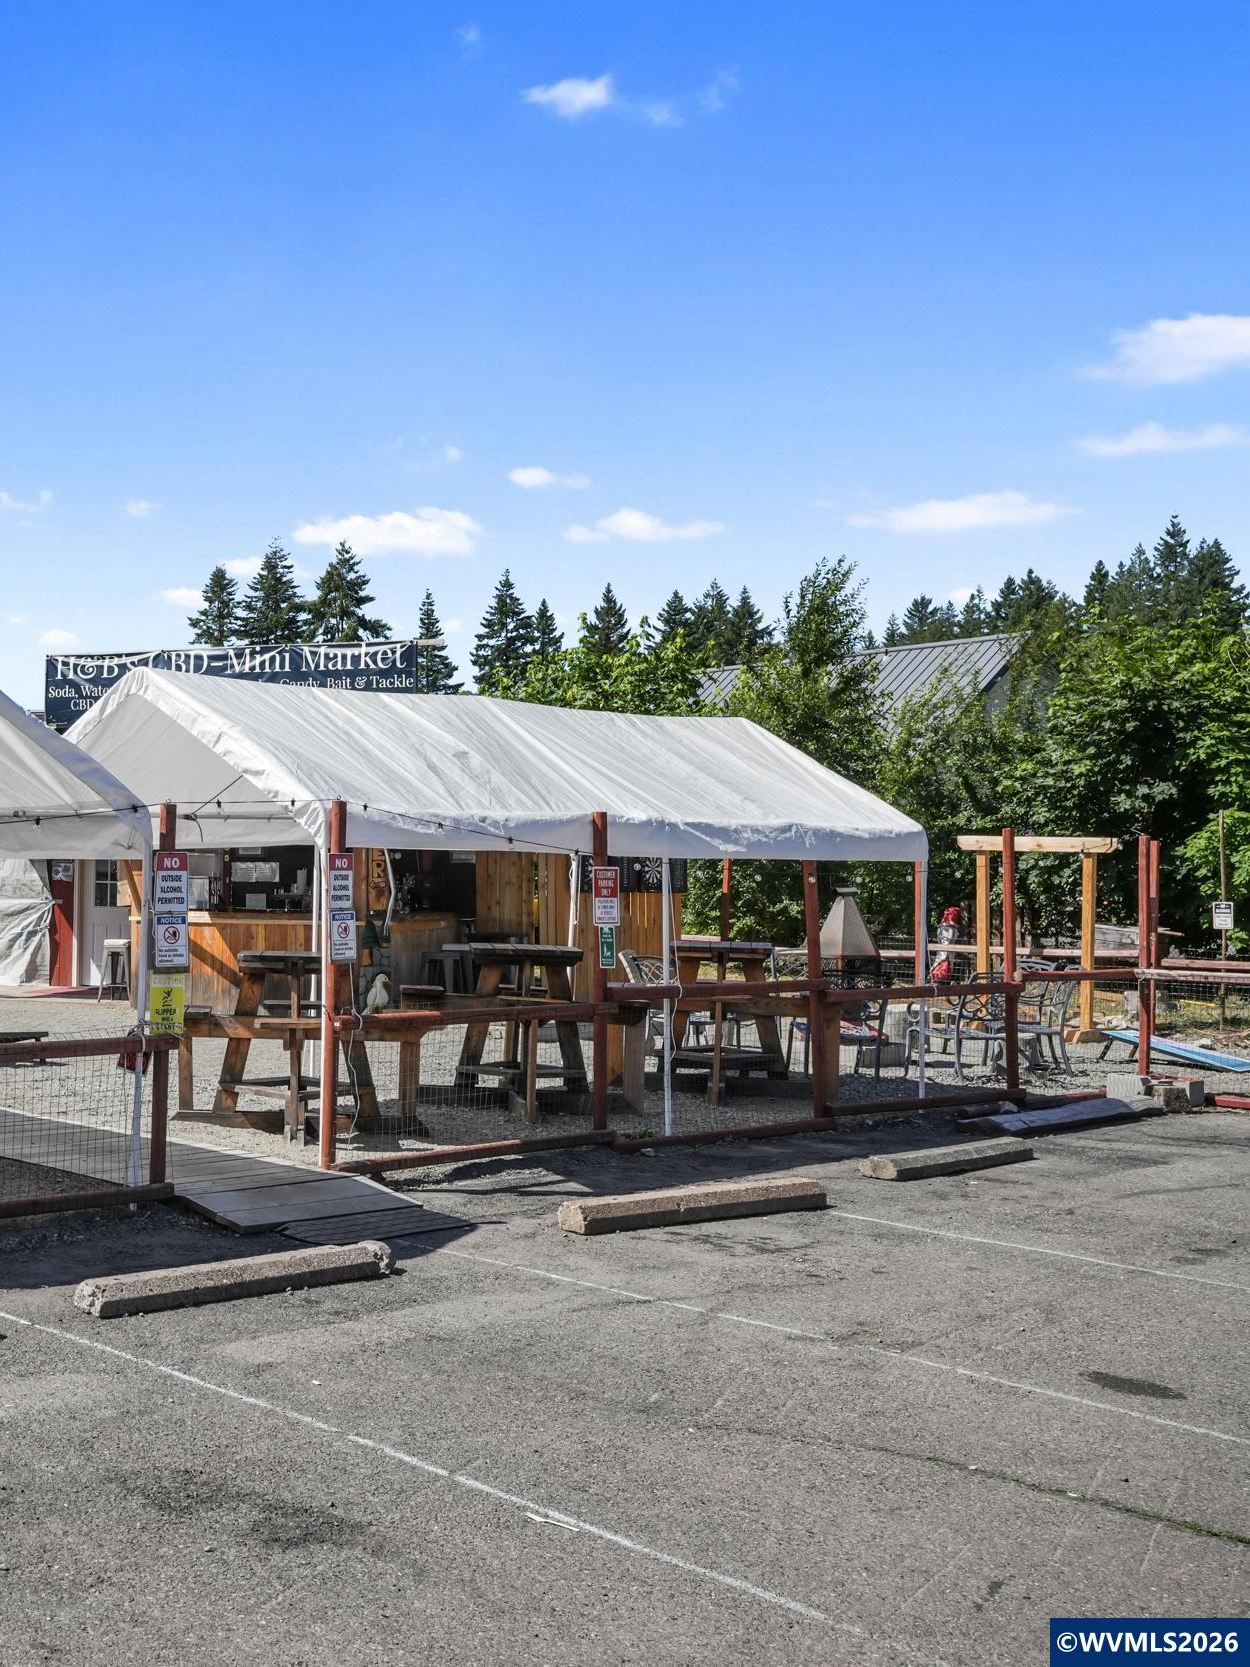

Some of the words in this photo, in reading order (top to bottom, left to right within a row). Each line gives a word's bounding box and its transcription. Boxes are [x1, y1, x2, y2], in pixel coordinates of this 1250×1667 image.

[301, 642, 407, 672] Market
[327, 677, 353, 690] Bait
[355, 677, 368, 689] &
[370, 674, 414, 688] Tackle
[48, 685, 79, 698] Soda,
[80, 685, 111, 697] Wate
[163, 858, 180, 868] NO
[335, 858, 348, 868] NO
[596, 870, 615, 878] CUSTOMER
[598, 879, 614, 887] PARKING
